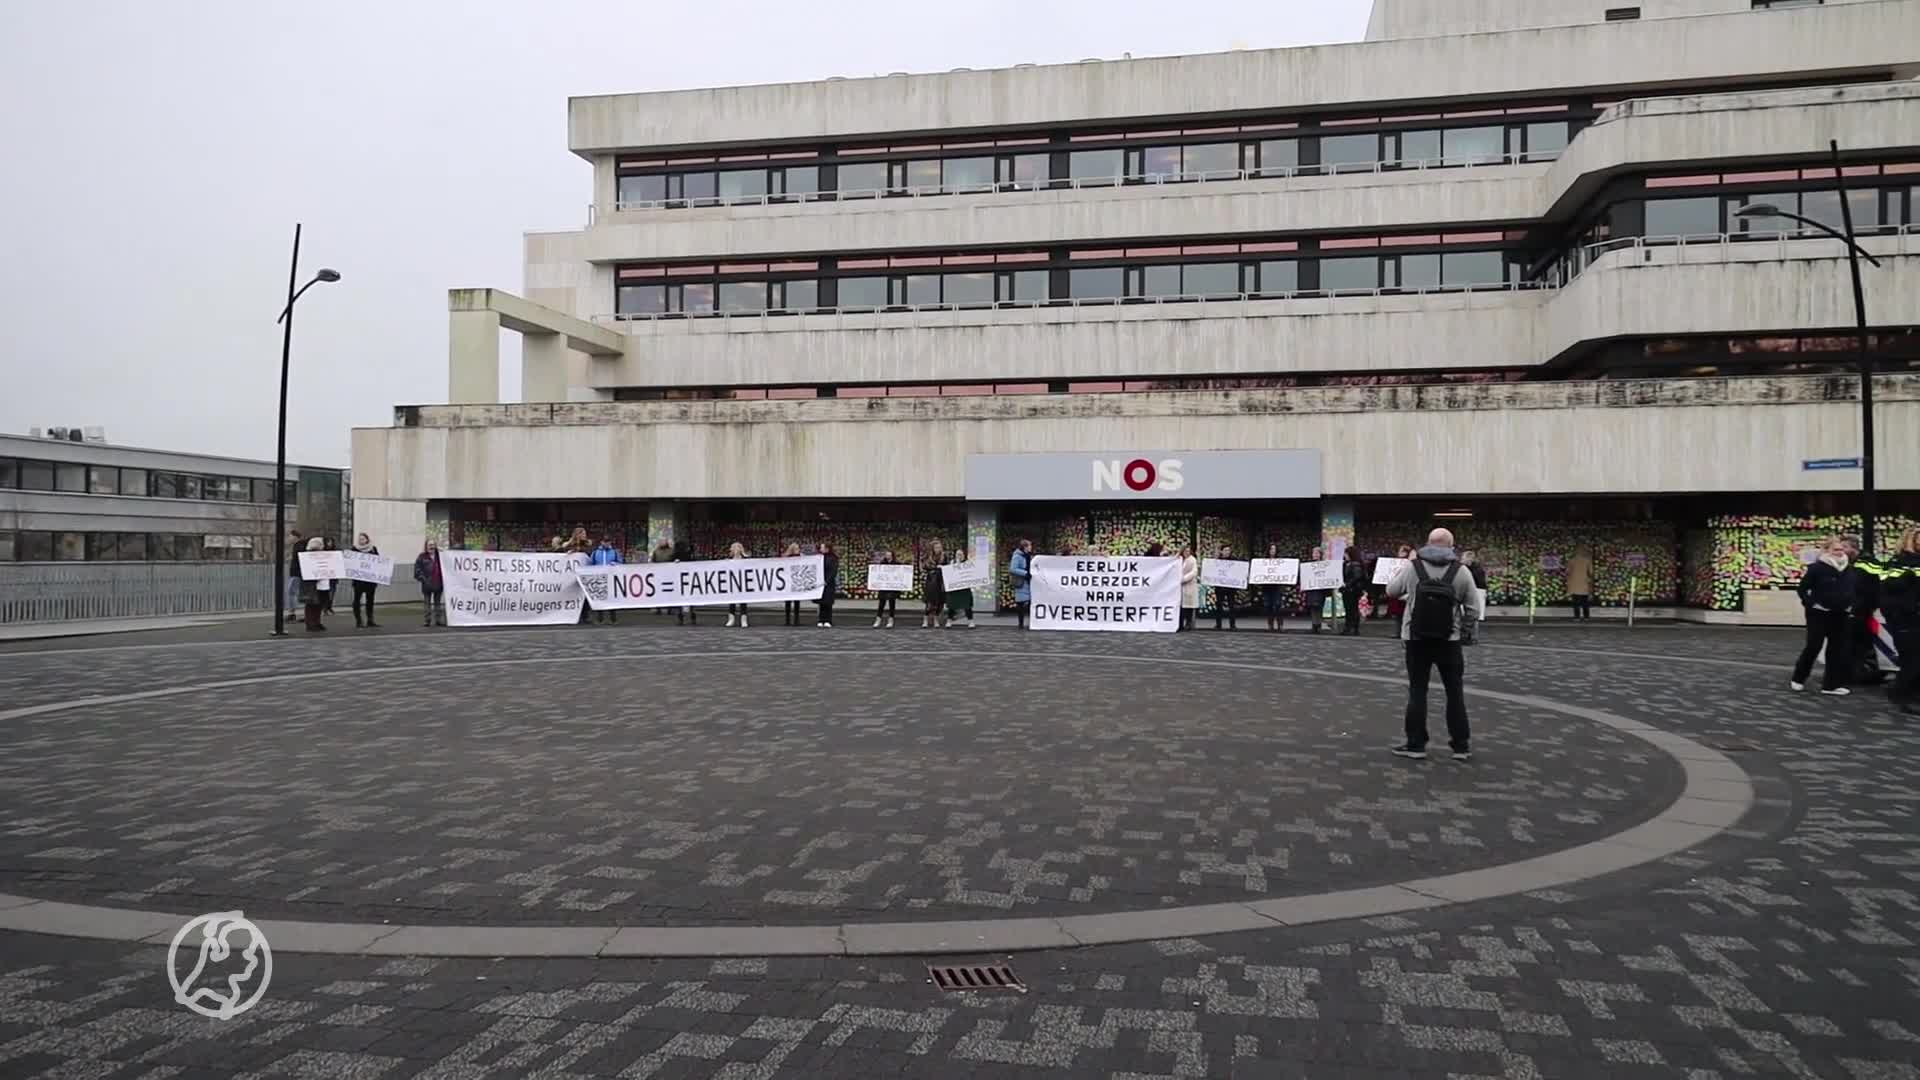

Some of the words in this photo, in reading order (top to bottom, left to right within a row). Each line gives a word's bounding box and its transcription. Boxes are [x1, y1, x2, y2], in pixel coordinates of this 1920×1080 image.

[1092, 458, 1184, 492] NOS
[454, 557, 481, 573] NOS,
[511, 559, 535, 574] SBS,
[1077, 561, 1139, 573] EERLIJK
[1264, 558, 1285, 566] STOP
[1311, 561, 1328, 570] STOP
[472, 578, 525, 595] Telegraaf,
[528, 579, 562, 593] Trouw
[613, 573, 656, 598] NOS
[661, 581, 675, 592] =
[680, 566, 786, 596] FAKENEWS
[1061, 575, 1151, 587] ONDERZOEK
[1086, 591, 1125, 602] NAAR
[466, 597, 486, 614] zijn
[488, 597, 517, 615] jullie
[520, 598, 561, 614] leugens
[1035, 604, 1175, 622] OVERSTERFTE
